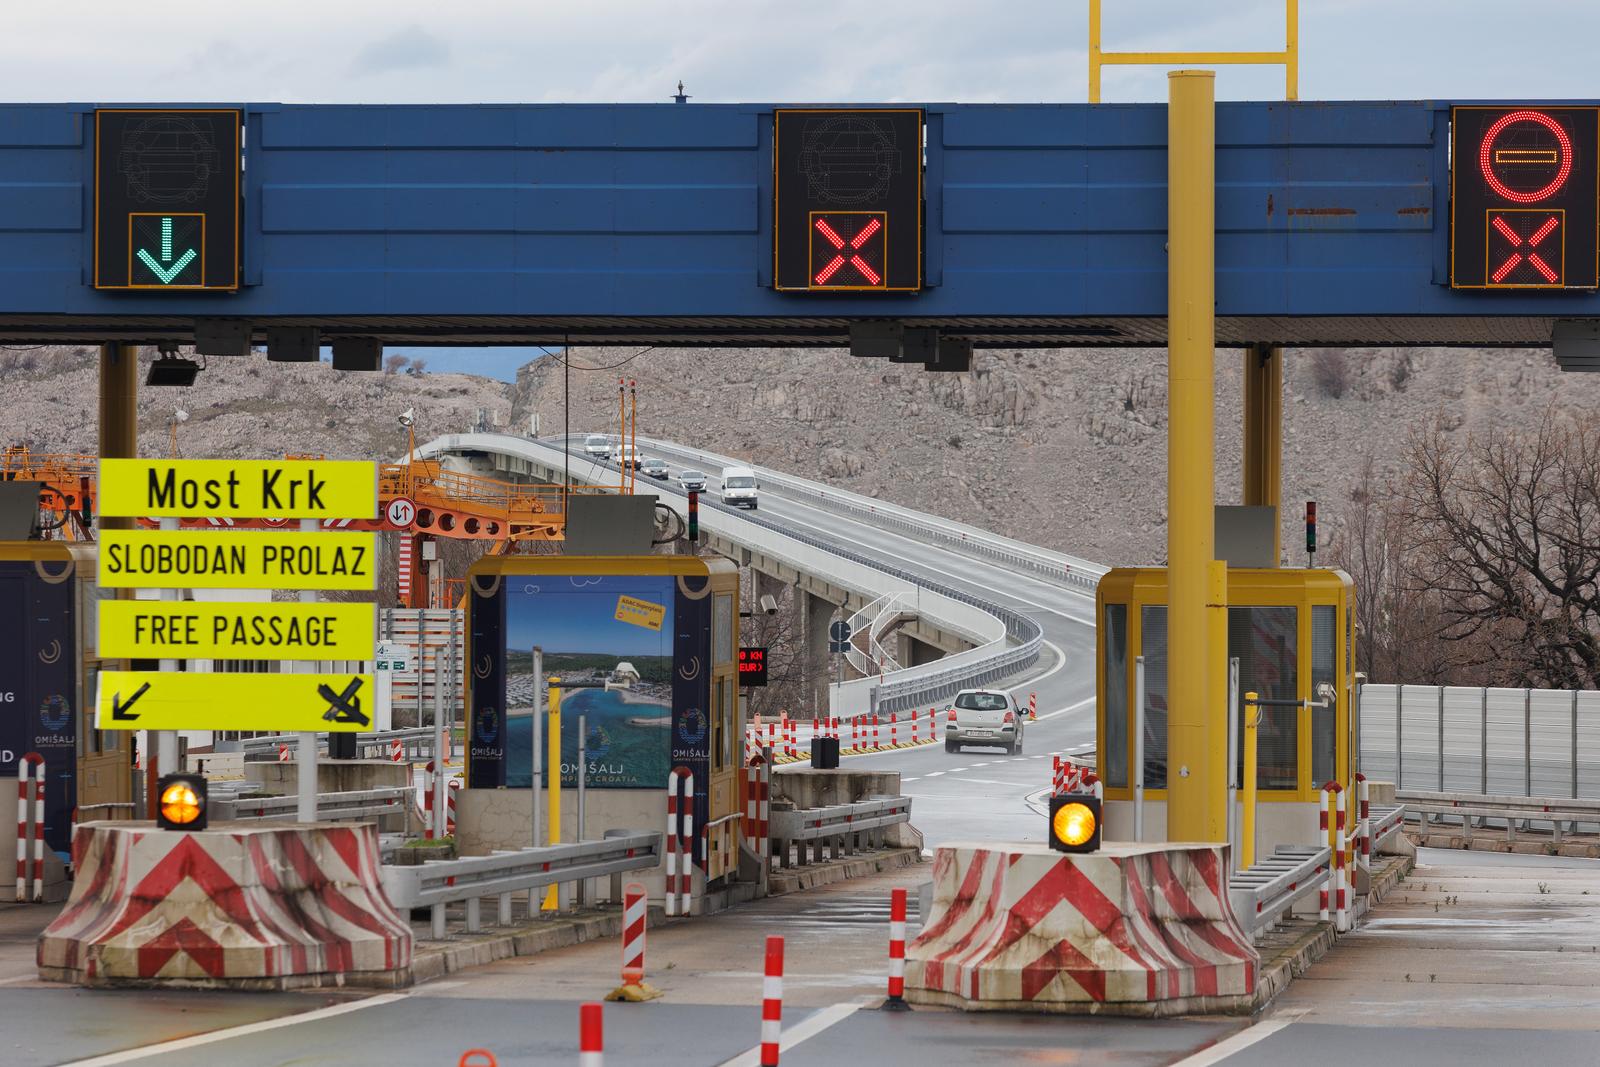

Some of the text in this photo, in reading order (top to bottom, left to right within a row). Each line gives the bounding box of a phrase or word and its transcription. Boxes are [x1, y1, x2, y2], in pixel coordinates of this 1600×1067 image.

[148, 467, 326, 510] Most Krk
[107, 543, 366, 576] SLOBODAN PROLAZ
[135, 614, 337, 647] FREE PASSAGE
[750, 650, 763, 660] KN
[34, 733, 75, 744] OMIŠALJ
[471, 746, 503, 757] OMIŠALJ
[595, 775, 638, 783] CROATIA
